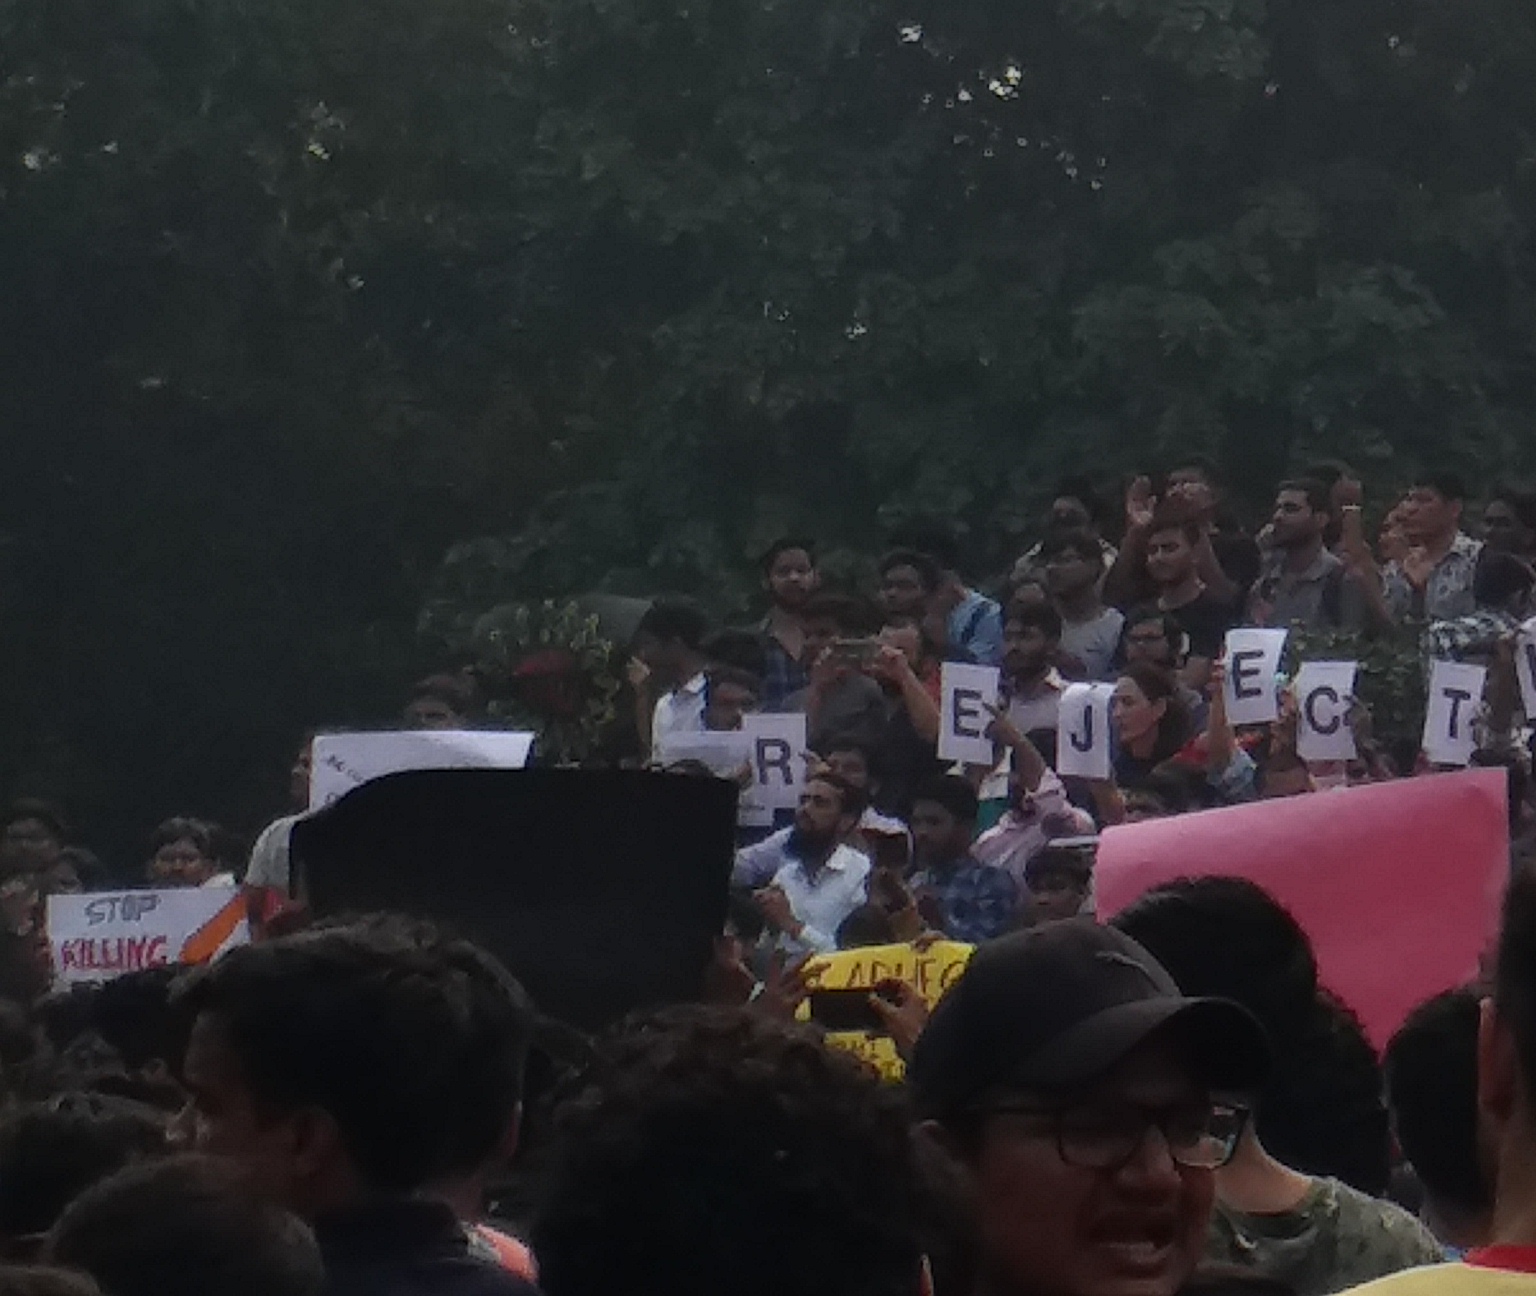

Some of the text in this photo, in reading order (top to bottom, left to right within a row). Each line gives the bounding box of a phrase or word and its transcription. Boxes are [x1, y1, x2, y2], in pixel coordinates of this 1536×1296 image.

[1231, 649, 1264, 700] E
[1070, 705, 1095, 753] J
[1305, 685, 1340, 735] C
[1441, 687, 1472, 740] T
[756, 736, 794, 786] R
[60, 935, 168, 971] KILLING
